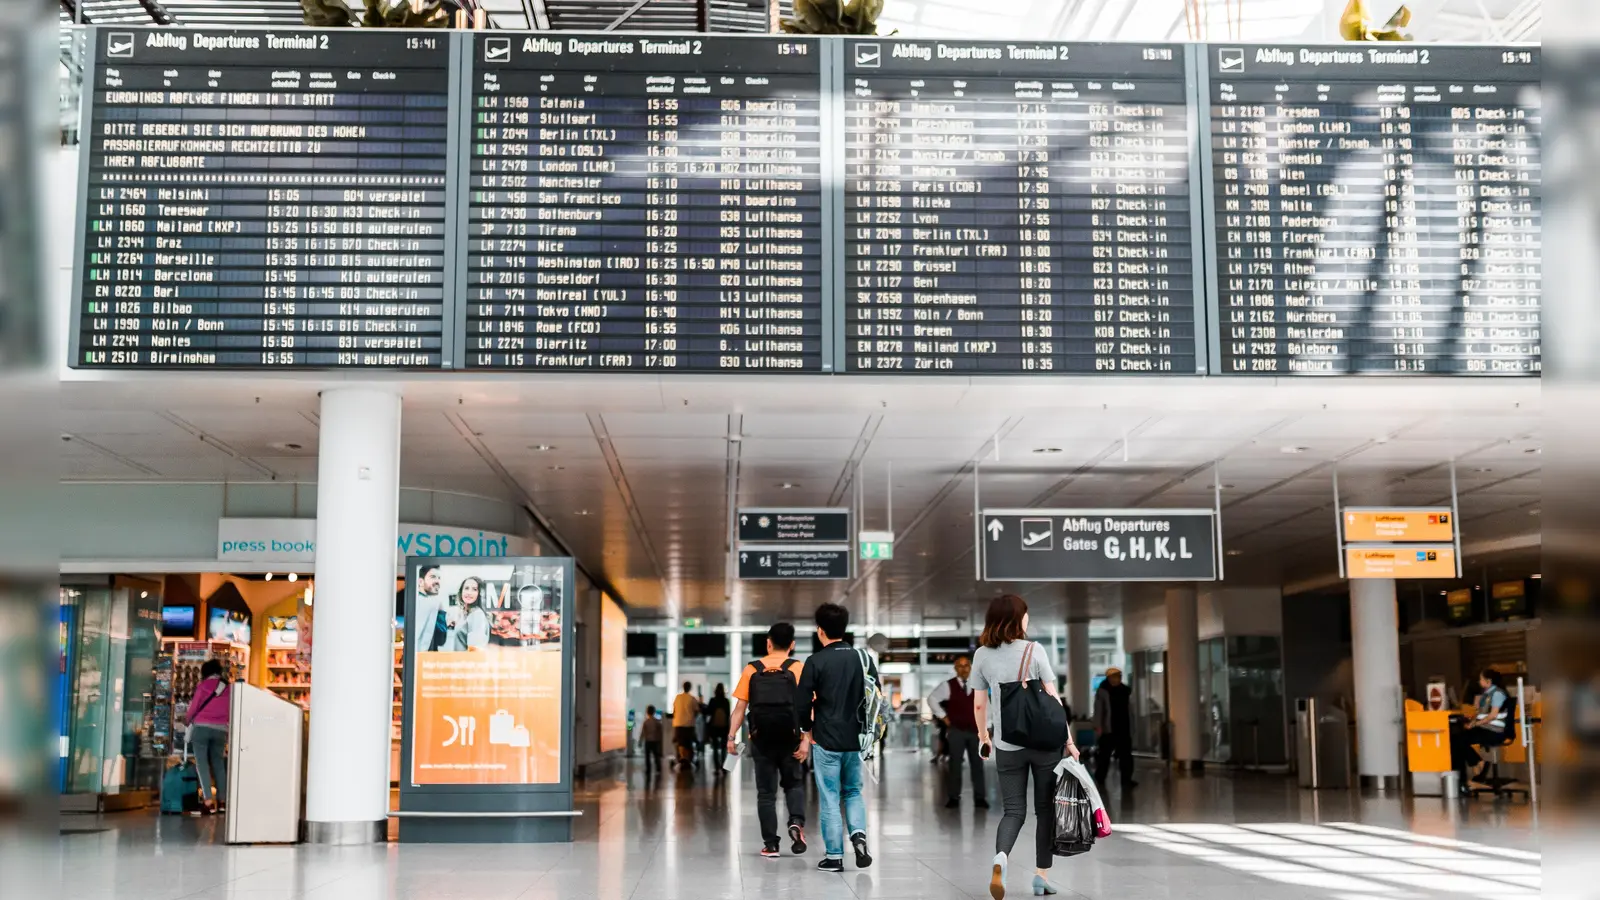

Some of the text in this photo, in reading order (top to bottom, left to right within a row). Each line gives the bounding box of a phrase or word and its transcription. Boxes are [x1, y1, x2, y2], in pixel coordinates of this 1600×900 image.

[146, 32, 329, 50] Abflug Departures Terminal 2
[407, 38, 436, 49] 15:41
[522, 38, 702, 55] Abflug Departures Terminal 2
[778, 44, 807, 54] 15:41
[892, 43, 1068, 61] Abflug Departures Terminal 2
[1142, 49, 1172, 60] 15:41
[1256, 48, 1429, 65] Abflug Departures Terminal 2
[1502, 52, 1531, 63] 15:41
[106, 92, 164, 103] EUROWINGS
[220, 93, 259, 104] FINDEN
[303, 94, 334, 105] STATT
[483, 113, 497, 123] LH
[540, 113, 596, 124] Stuttgart
[648, 115, 678, 125] 15:55
[1276, 107, 1320, 117] Dresden
[1475, 108, 1524, 119] Check-in
[104, 124, 365, 137] BITTE BEGEBEN SIE SICH AUFGRUND DES HOHEN
[104, 140, 320, 153] PASSAGIERAUFKOMMENS RECHTZEITIG ZU
[104, 156, 205, 168] IHREM ABFLUGGATE
[101, 188, 113, 200] LH
[120, 188, 146, 200] 2464
[159, 189, 209, 200] Helsinki
[268, 190, 299, 201] 15:05
[100, 205, 112, 215] LH
[120, 205, 145, 215] 1660
[159, 205, 209, 216] Temeswar
[268, 206, 299, 217] 15:20
[306, 206, 336, 217] 16:30
[369, 207, 419, 218] Check-in
[507, 224, 526, 235] 713
[538, 225, 576, 236] Tirana
[647, 226, 677, 236] 16:20
[745, 228, 802, 238] Lufthansa
[481, 240, 802, 254] LH 2274 Nice 16:25 K07 Lufthansa
[1229, 264, 1315, 274] LH 1754 Athen
[97, 269, 110, 280] LH
[155, 270, 213, 281] Barcelona
[265, 271, 296, 282] 15:45
[341, 271, 360, 282] K10
[367, 272, 430, 283] aufgerufen
[858, 277, 870, 287] LX
[877, 277, 901, 287] 1127
[914, 277, 938, 288] Genf
[1119, 279, 1168, 290] Check-in
[95, 302, 108, 313] LH
[153, 303, 192, 313] Bilbao
[264, 303, 295, 314] 15:45
[340, 304, 360, 315] K14
[366, 304, 430, 316] aufgerufen
[479, 305, 492, 316] LH
[504, 305, 524, 316] 714
[537, 306, 568, 316] Tokyo
[646, 307, 677, 318] 16:40
[745, 308, 802, 318] Lufthansa
[858, 325, 871, 335] LH
[877, 325, 902, 336] 2114
[914, 326, 952, 336] Bremen
[1120, 327, 1170, 338] Check-in
[92, 352, 105, 362] LH
[112, 352, 138, 362] 2510
[150, 352, 215, 363] Birmingham
[262, 353, 293, 363] 15:55
[364, 354, 428, 365] aufgerufen
[858, 358, 871, 368] LH
[877, 358, 902, 368] 2372
[915, 358, 952, 368] Zürich
[1121, 359, 1171, 370] Check-in
[1063, 518, 1170, 534] Abflug Departures
[222, 540, 317, 554] press book
[398, 532, 508, 557] wspoint
[1063, 537, 1098, 550] Gates
